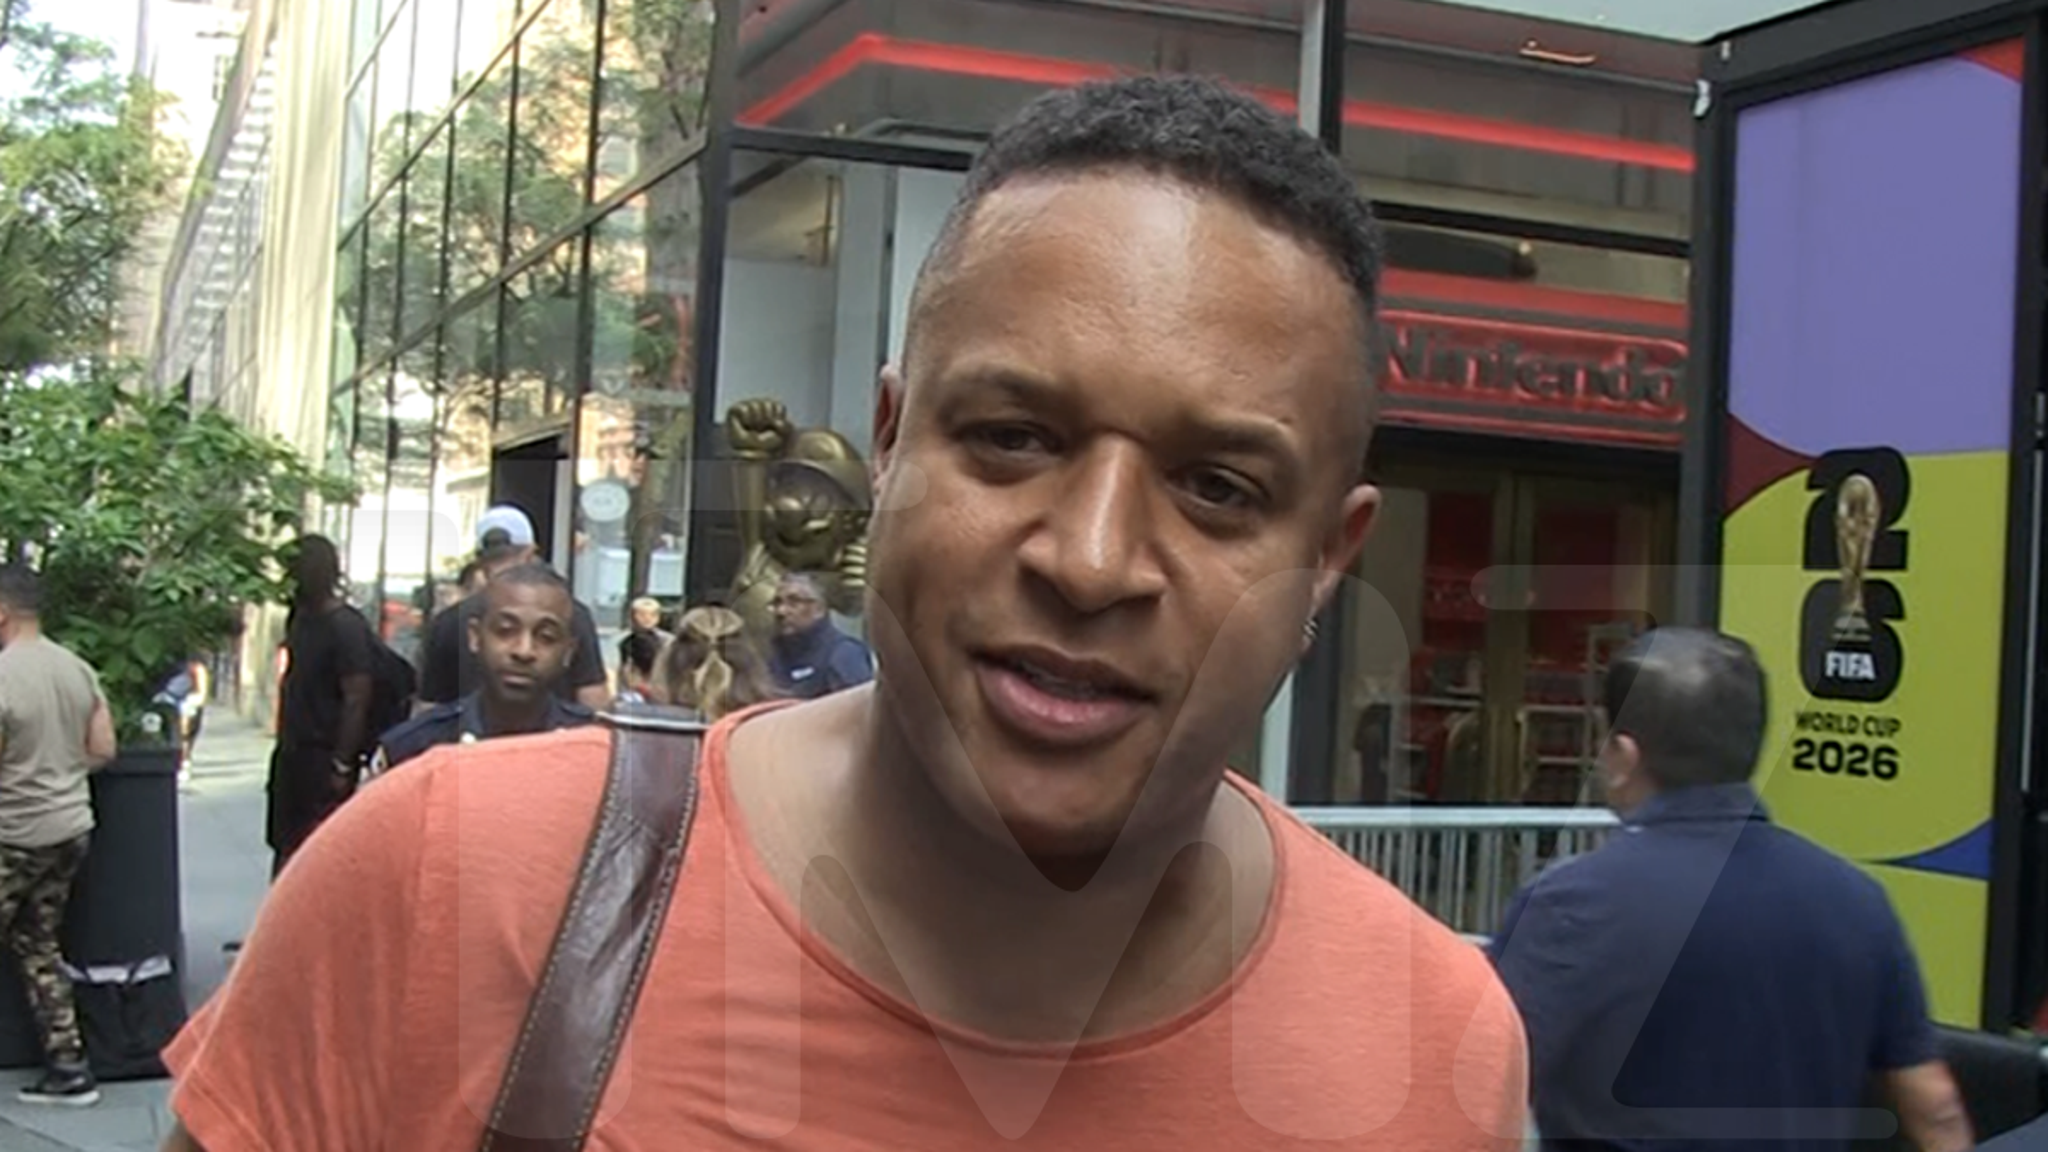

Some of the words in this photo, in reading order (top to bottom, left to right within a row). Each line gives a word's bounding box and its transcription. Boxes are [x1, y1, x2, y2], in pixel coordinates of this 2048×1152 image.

[1383, 323, 1689, 410] Nintendo
[1825, 651, 1876, 681] FIFA
[1797, 712, 1860, 735] WORLD
[1863, 715, 1902, 738] CUP
[1792, 738, 1900, 780] 2026
